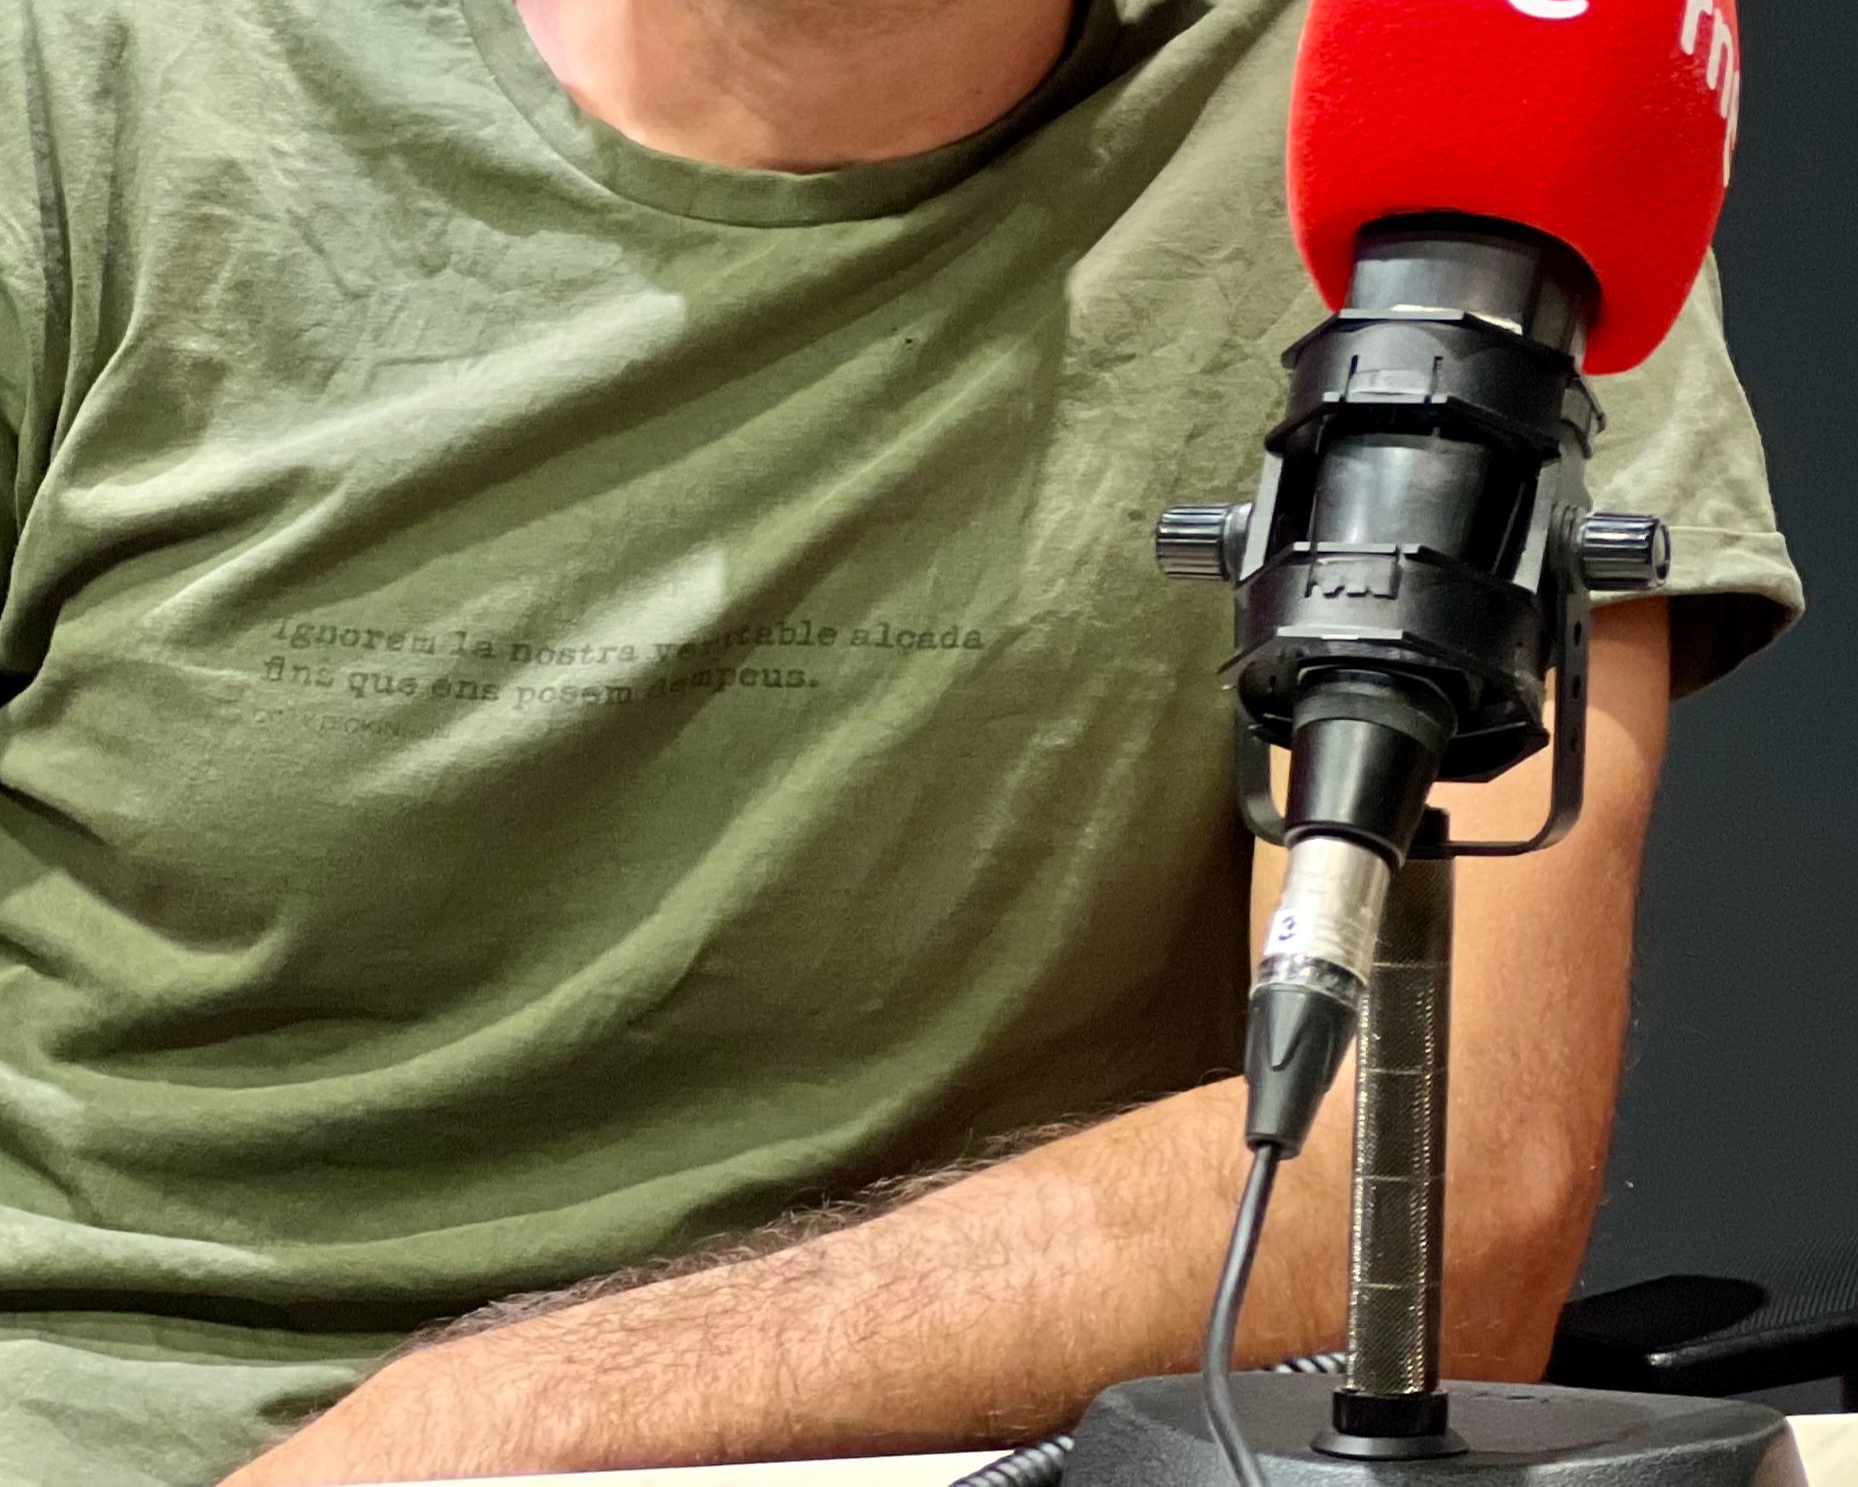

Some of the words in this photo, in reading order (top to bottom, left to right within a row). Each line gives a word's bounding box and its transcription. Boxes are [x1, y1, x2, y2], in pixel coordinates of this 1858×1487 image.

[449, 630, 496, 659] la
[509, 642, 638, 666] nostra
[849, 621, 986, 656] alçada
[347, 671, 419, 699] que
[431, 678, 500, 701] ens
[513, 684, 634, 711] posem
